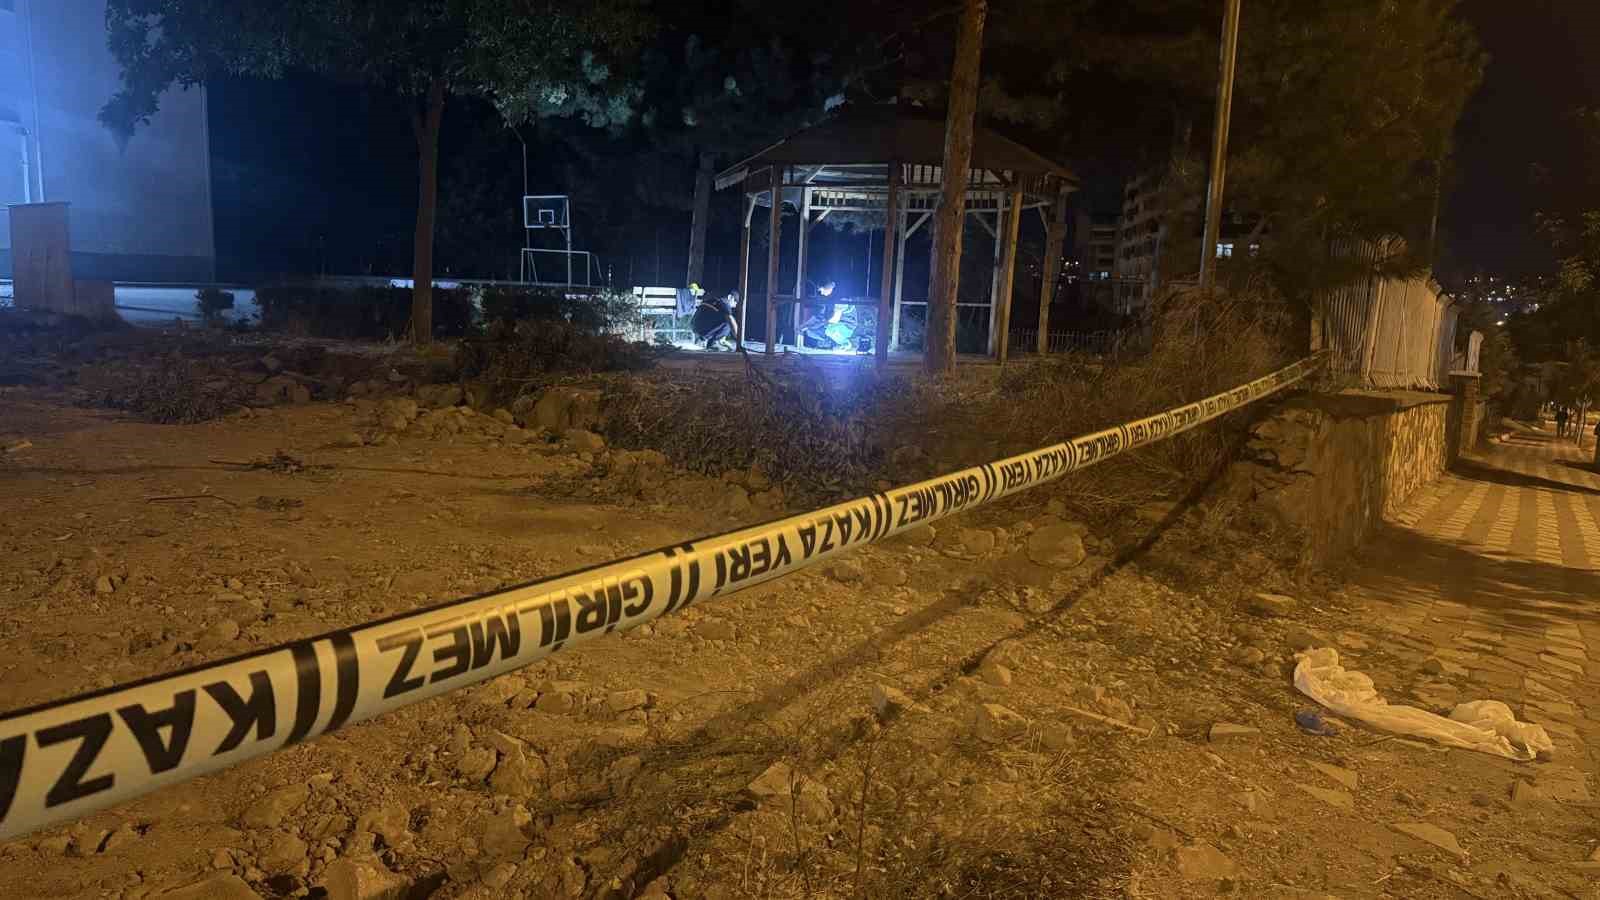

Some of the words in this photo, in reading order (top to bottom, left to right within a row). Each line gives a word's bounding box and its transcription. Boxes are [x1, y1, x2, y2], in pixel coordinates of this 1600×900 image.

[1033, 447, 1068, 481] KAZA
[797, 505, 872, 559] KAZA
[711, 532, 792, 596] YERİ
[376, 566, 654, 699] GİRİLMEZ
